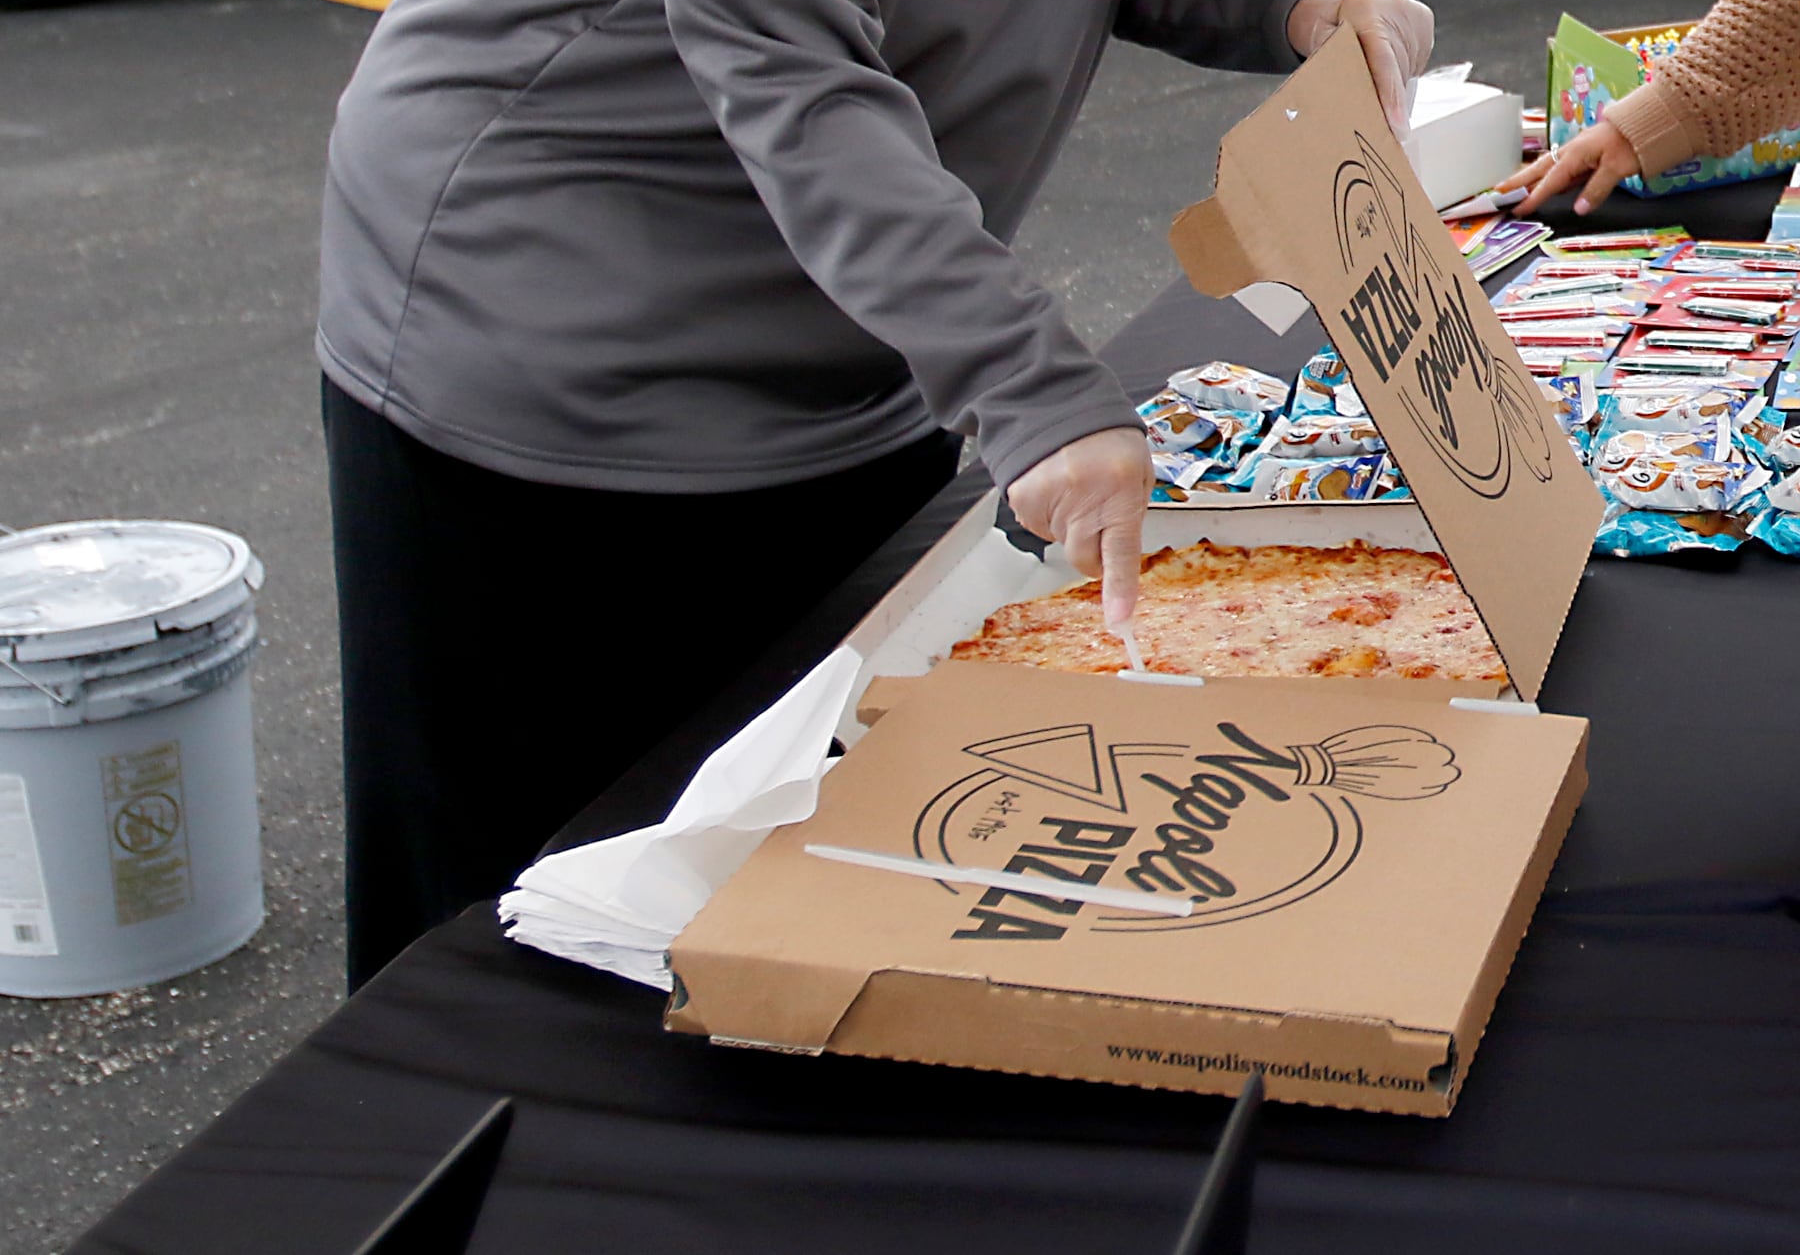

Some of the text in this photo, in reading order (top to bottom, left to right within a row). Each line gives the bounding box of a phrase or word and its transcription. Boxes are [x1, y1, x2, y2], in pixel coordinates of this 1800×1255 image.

[1340, 251, 1422, 384] PIZZA
[1414, 272, 1488, 451] Napoli
[950, 816, 1138, 940] PIZZA
[1124, 721, 1301, 904] Napoli
[1106, 1044, 1426, 1093] www.napoliswoodstock.com
